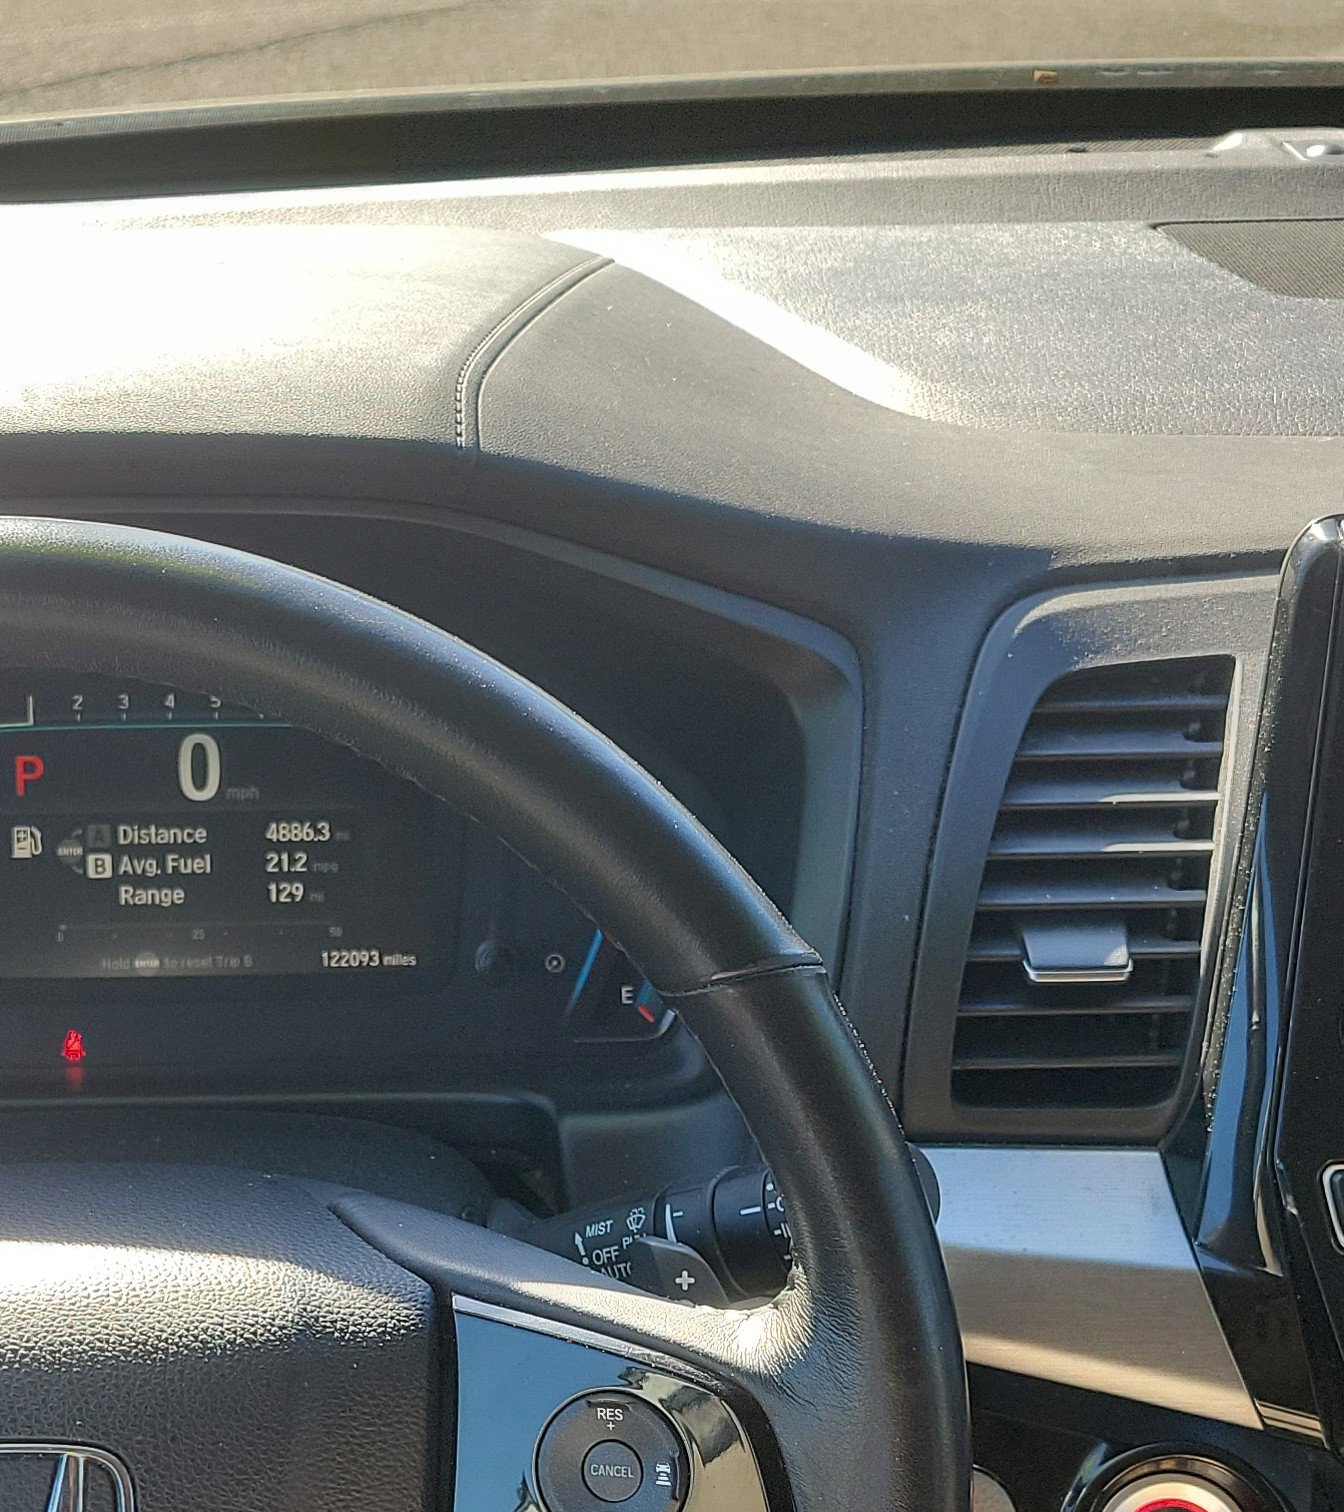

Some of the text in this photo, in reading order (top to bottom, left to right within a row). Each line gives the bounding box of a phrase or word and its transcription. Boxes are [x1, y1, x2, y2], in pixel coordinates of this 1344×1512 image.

[72, 694, 83, 710] 2
[118, 694, 129, 709] 3
[164, 693, 175, 709] 4
[15, 755, 45, 797] P
[178, 733, 220, 801] 0
[118, 825, 206, 845] Distance
[266, 822, 331, 843] 4886.3
[118, 855, 161, 878] Avg.
[166, 854, 211, 875] Fuel
[266, 852, 308, 873] 21.2
[119, 885, 185, 907] Range
[268, 882, 304, 902] 129
[321, 950, 417, 968] 122093 miles
[621, 986, 634, 1004] E
[585, 1219, 614, 1239] MIST
[592, 1245, 621, 1267] OFF
[597, 1408, 624, 1421] RES
[591, 1464, 635, 1478] CANCEL
